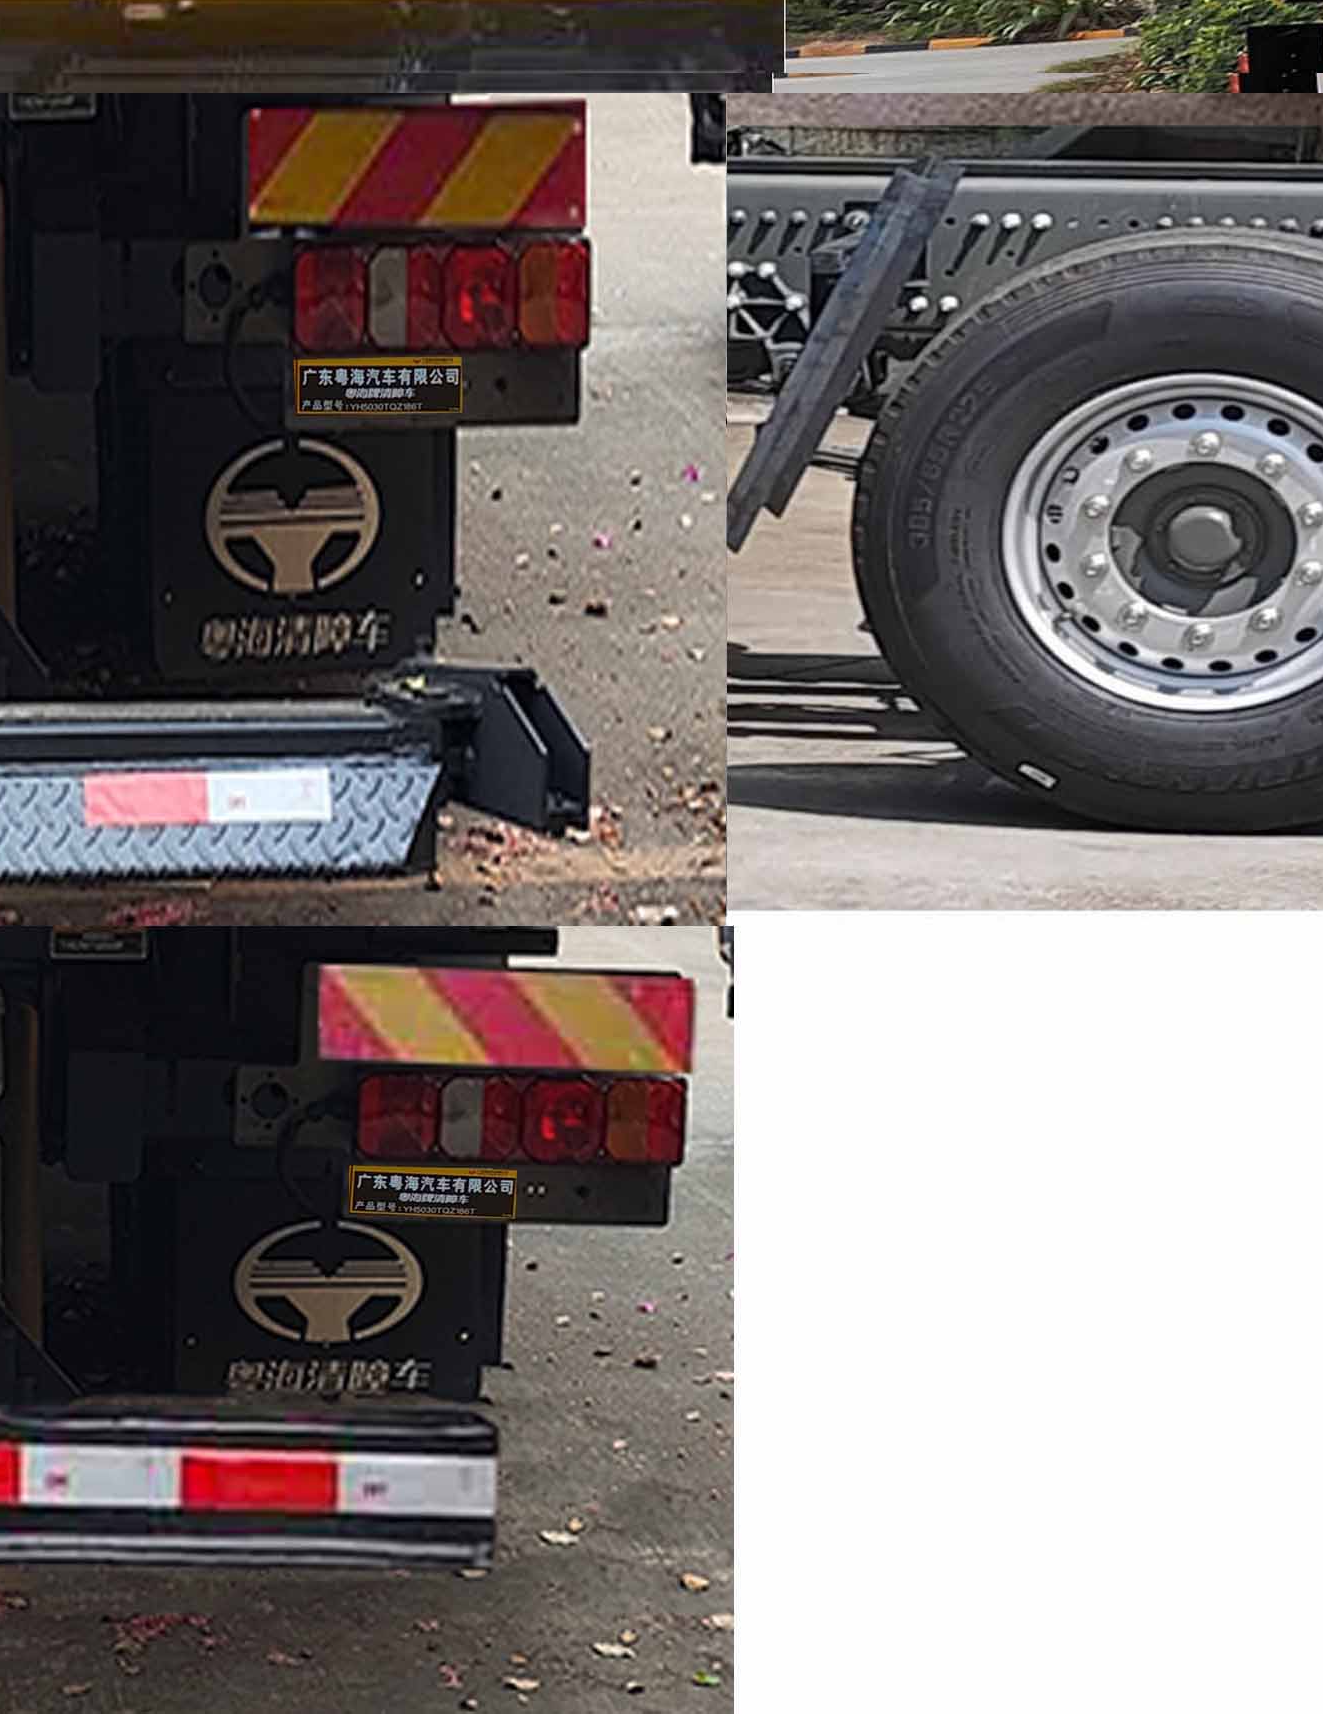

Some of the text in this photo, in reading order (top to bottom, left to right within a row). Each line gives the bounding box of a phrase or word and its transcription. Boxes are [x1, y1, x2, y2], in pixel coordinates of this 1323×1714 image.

[302, 367, 460, 386] 广东粤海汽车有限公司
[357, 1174, 514, 1195] 广东粤海汽车有限公司
